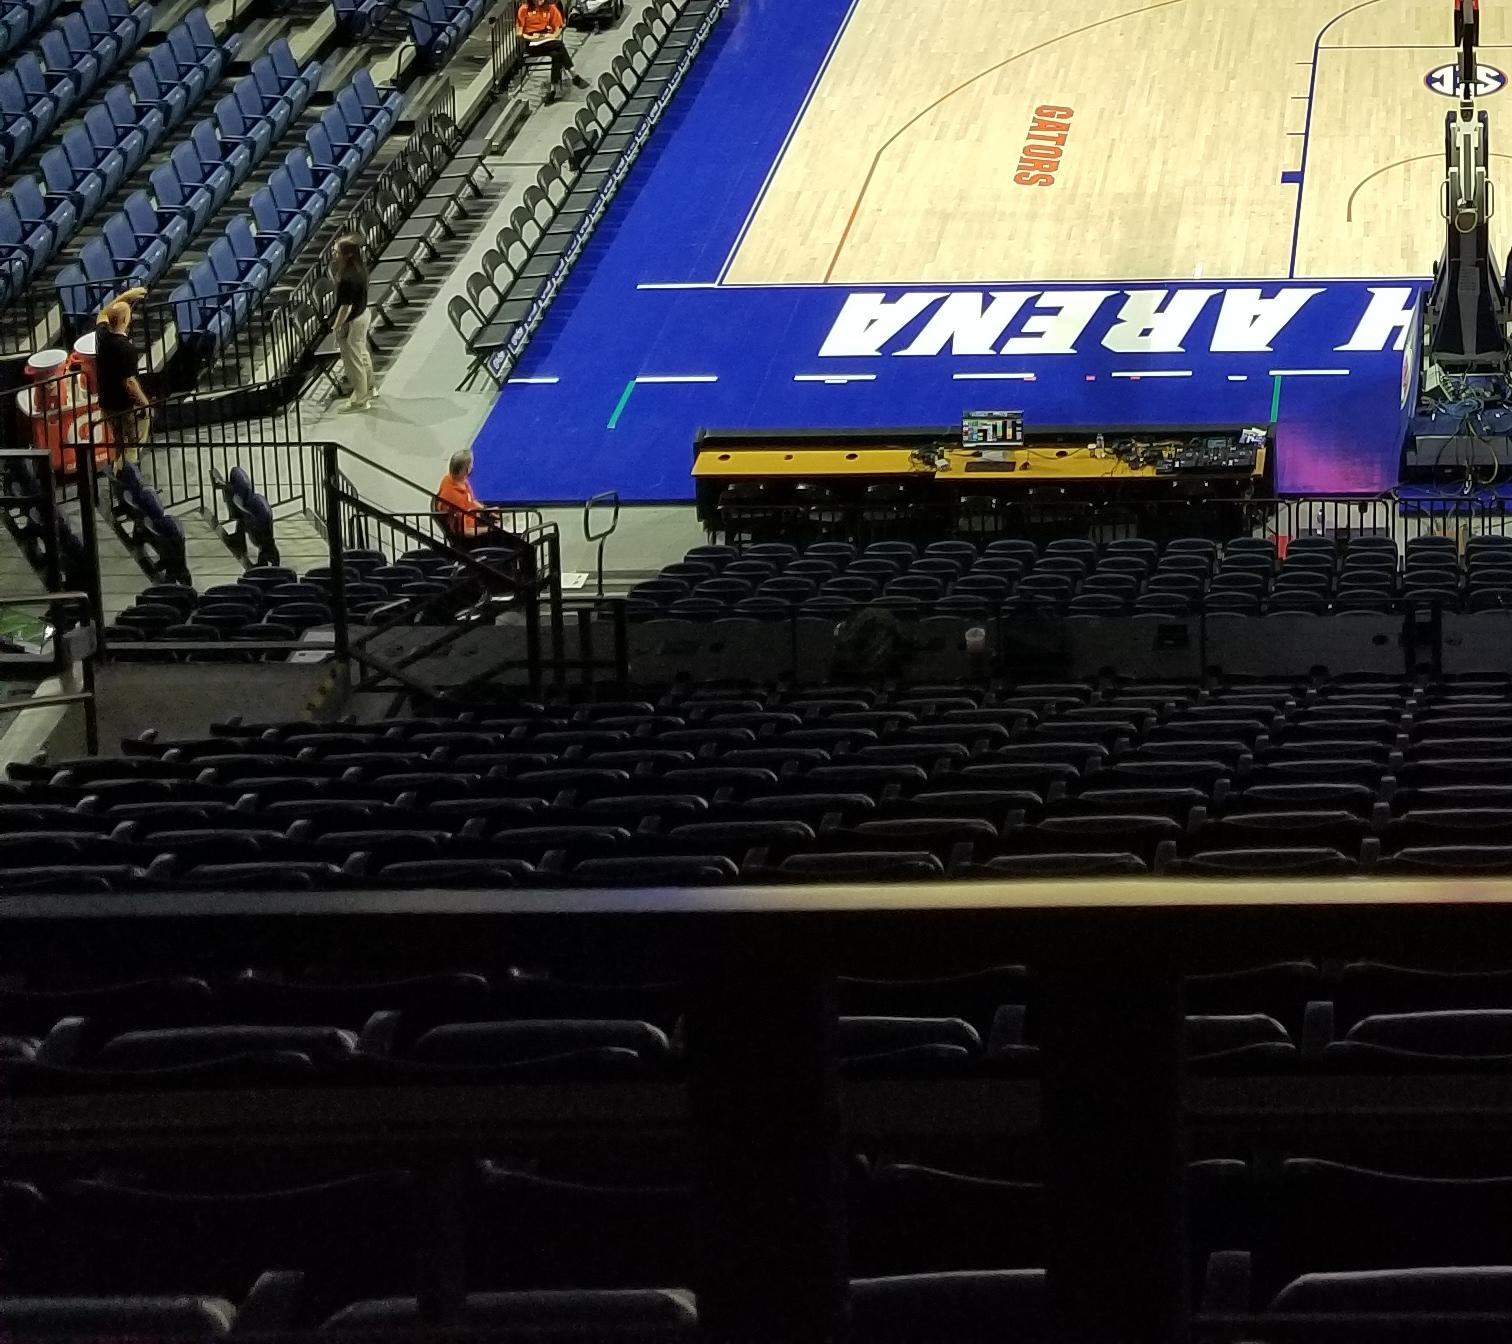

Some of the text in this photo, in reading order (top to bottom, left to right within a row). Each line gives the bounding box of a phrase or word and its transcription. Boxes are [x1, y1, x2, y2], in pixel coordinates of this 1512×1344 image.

[1431, 65, 1502, 96] SC
[1014, 104, 1075, 188] GATORS
[817, 287, 1329, 357] ARENA
